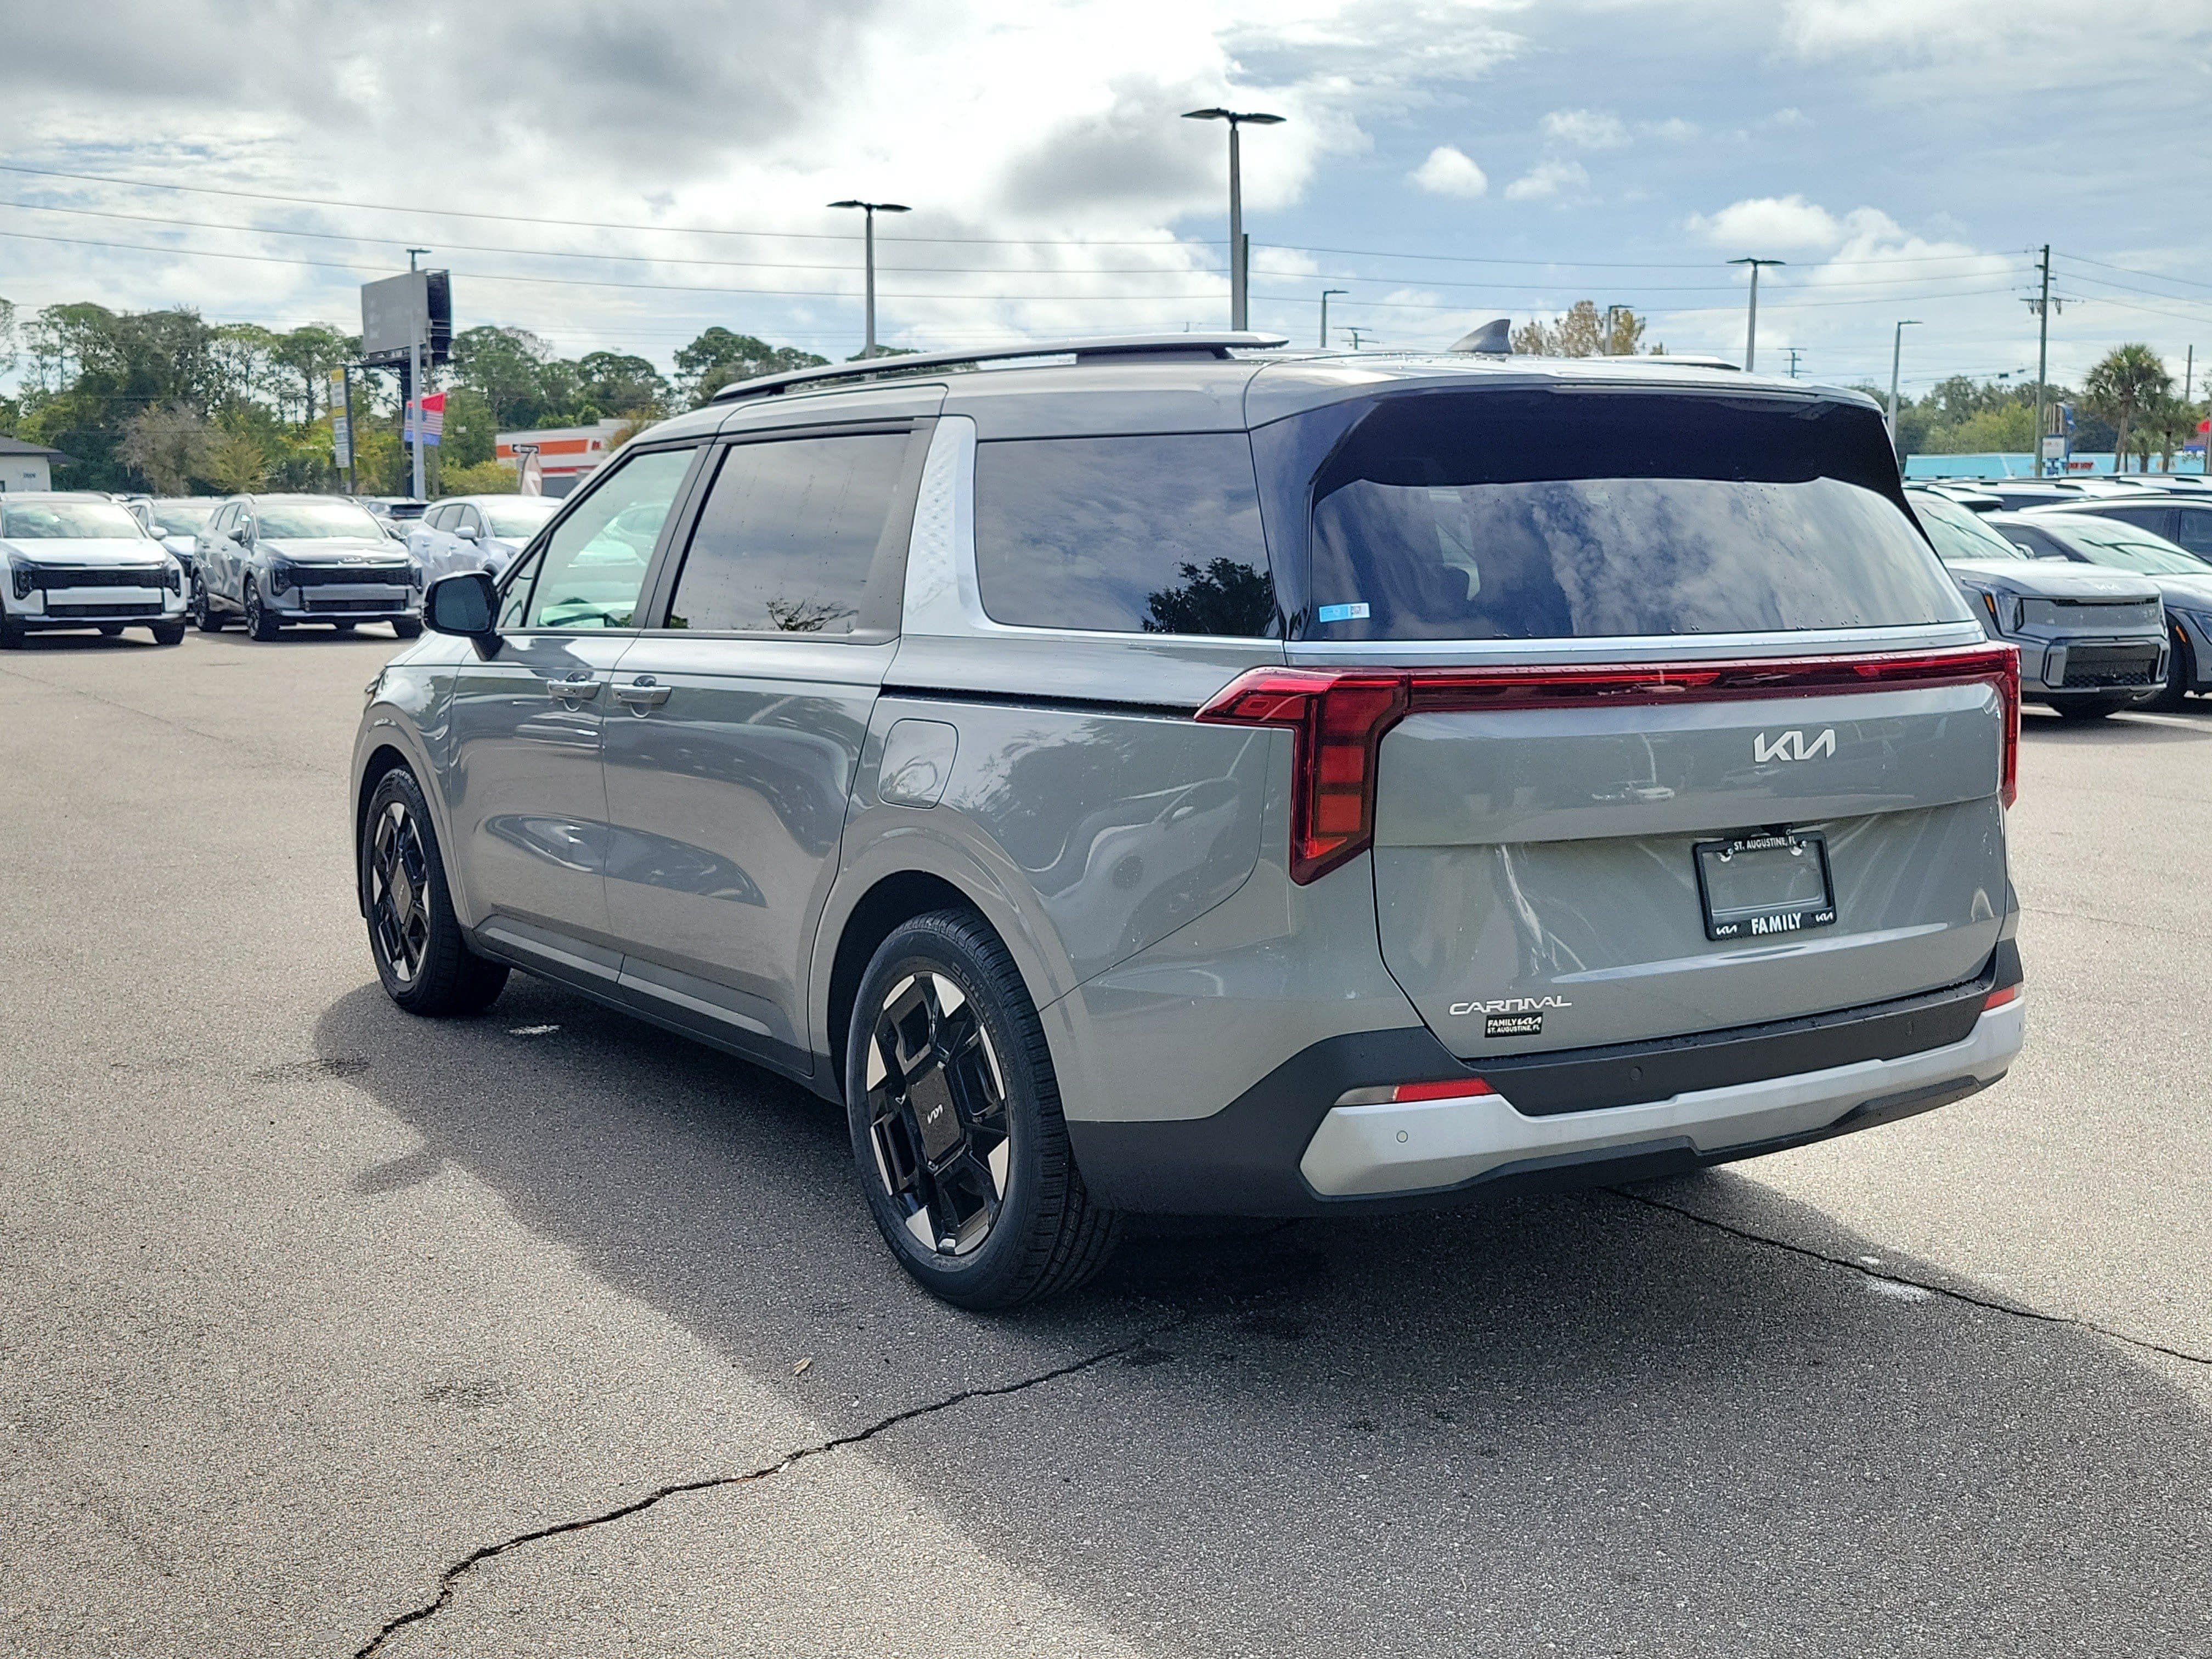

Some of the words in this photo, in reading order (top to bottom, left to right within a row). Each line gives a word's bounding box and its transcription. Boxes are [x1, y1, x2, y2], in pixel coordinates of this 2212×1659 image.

[1754, 729, 1836, 762] KIA
[1734, 841, 1745, 851] ST.
[1747, 837, 1787, 849] AUGUSTINE,
[1788, 836, 1796, 845] FL
[1751, 912, 1802, 935] FAMILY
[1449, 996, 1572, 1015] CARNIVAL
[1487, 1018, 1517, 1027] FAMILY
